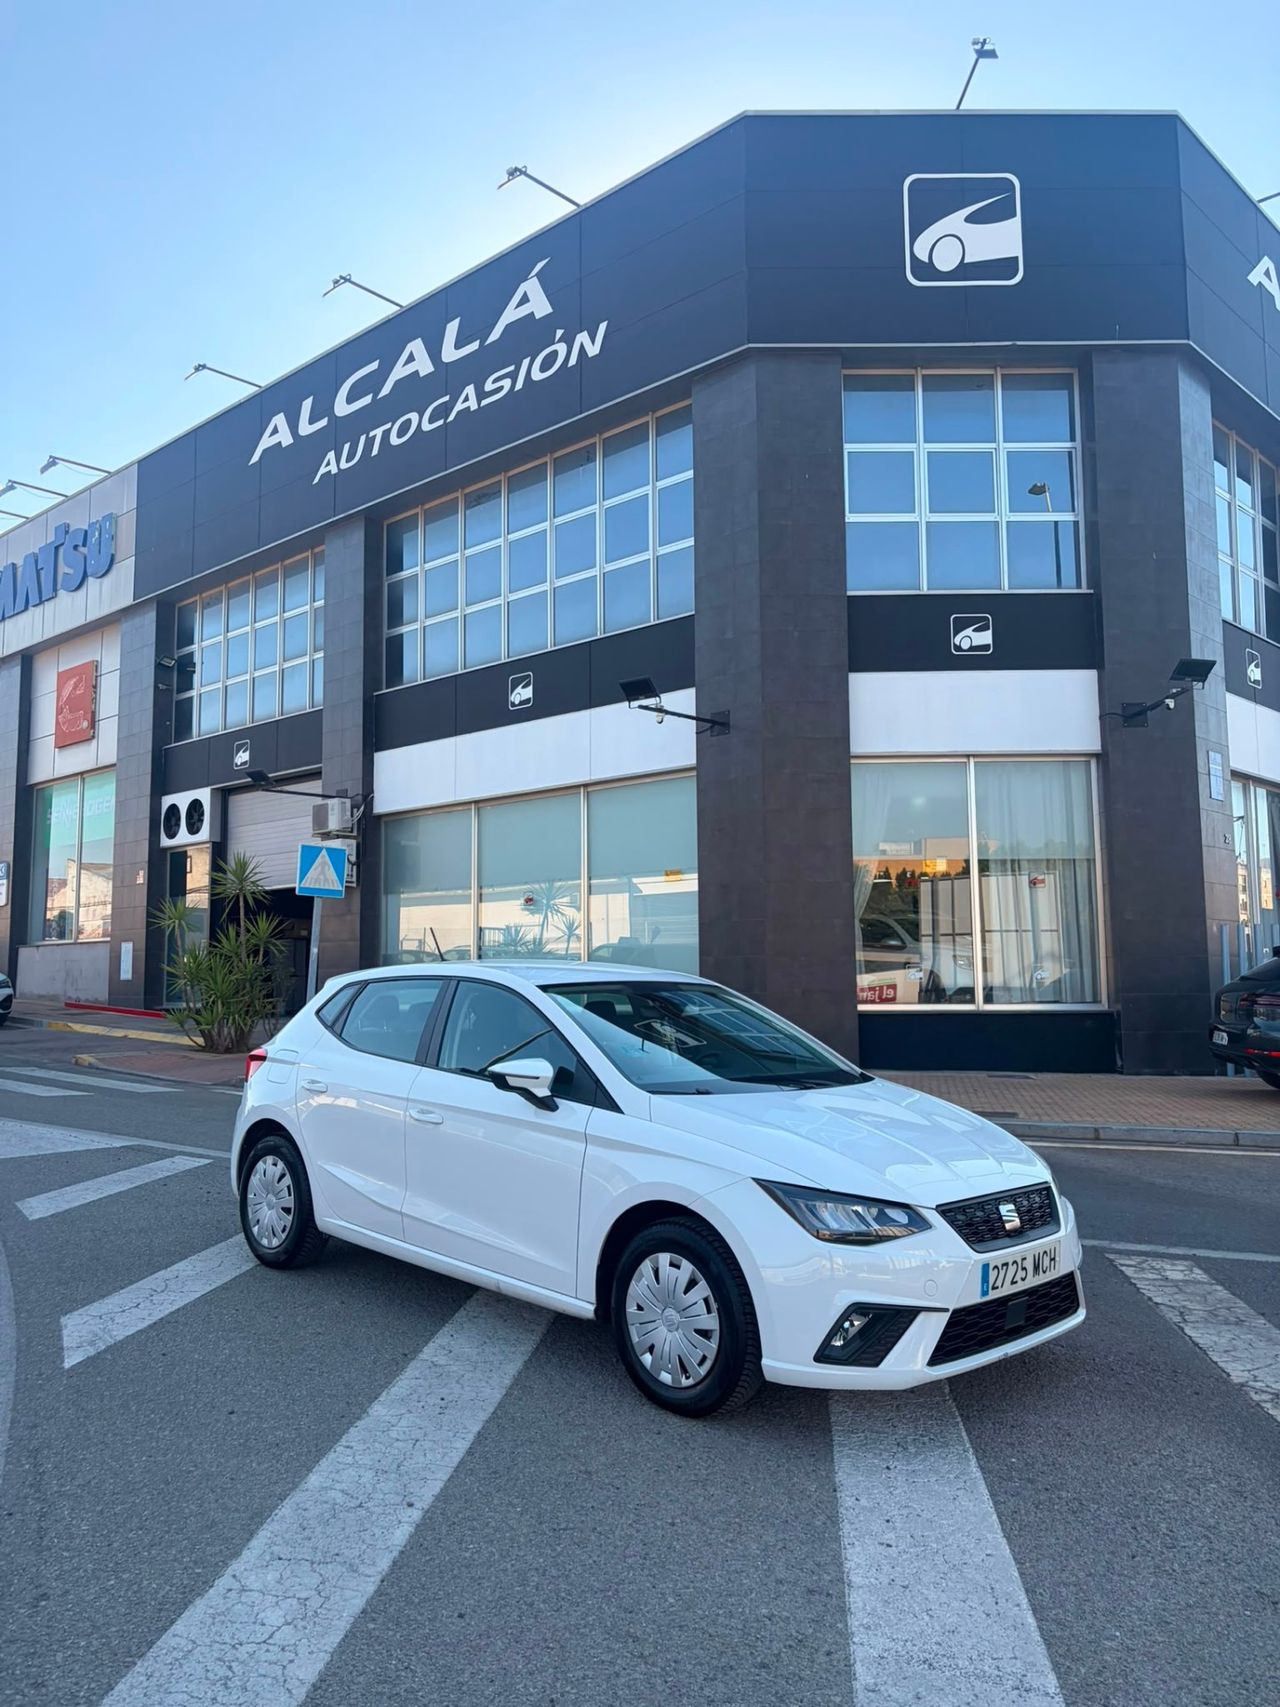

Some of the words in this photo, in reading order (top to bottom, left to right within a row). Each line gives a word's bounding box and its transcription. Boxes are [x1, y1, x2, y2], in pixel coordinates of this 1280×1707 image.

[248, 257, 554, 466] ALCALÁ
[312, 320, 609, 485] AUTOCASIÓN
[991, 1257, 1028, 1291] 2725
[1032, 1246, 1057, 1278] MCH
